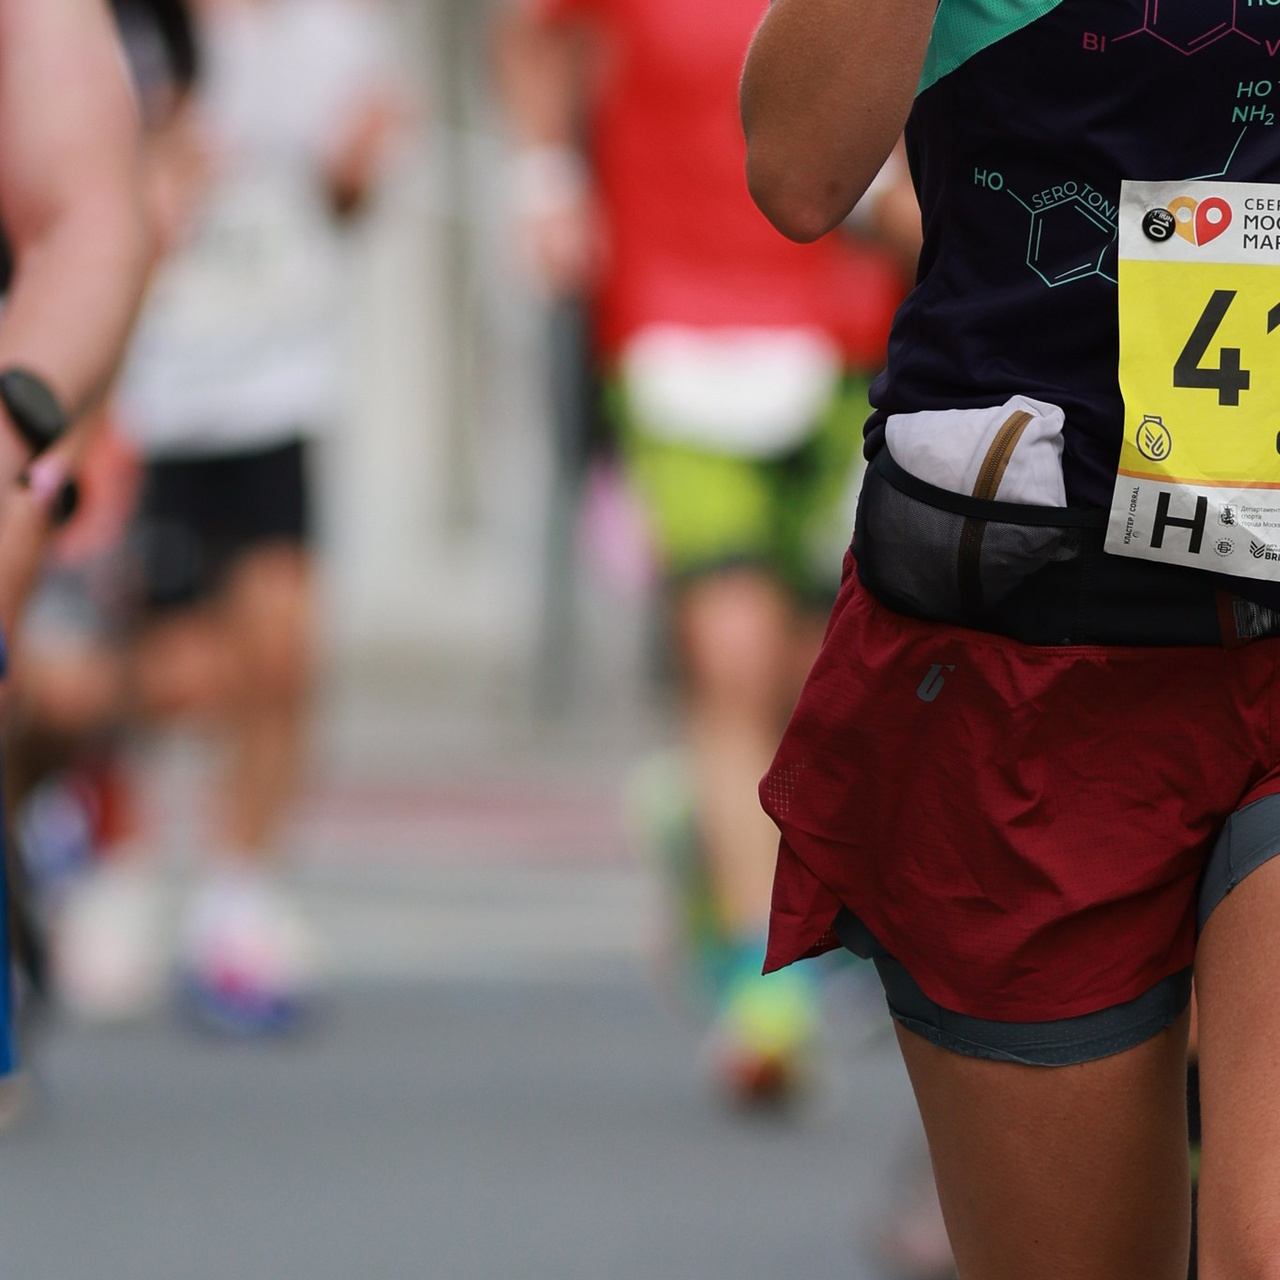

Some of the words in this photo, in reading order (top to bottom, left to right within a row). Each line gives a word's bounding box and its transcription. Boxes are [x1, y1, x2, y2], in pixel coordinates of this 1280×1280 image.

[1082, 31, 1106, 53] BI
[1236, 80, 1272, 98] HO
[974, 167, 1004, 190] HO
[1031, 181, 1119, 221] SEROTONI
[1149, 218, 1170, 238] 10
[1124, 516, 1134, 545] КЛАСТЕР
[1129, 486, 1140, 512] CORRAL
[1240, 506, 1280, 514] Департамент
